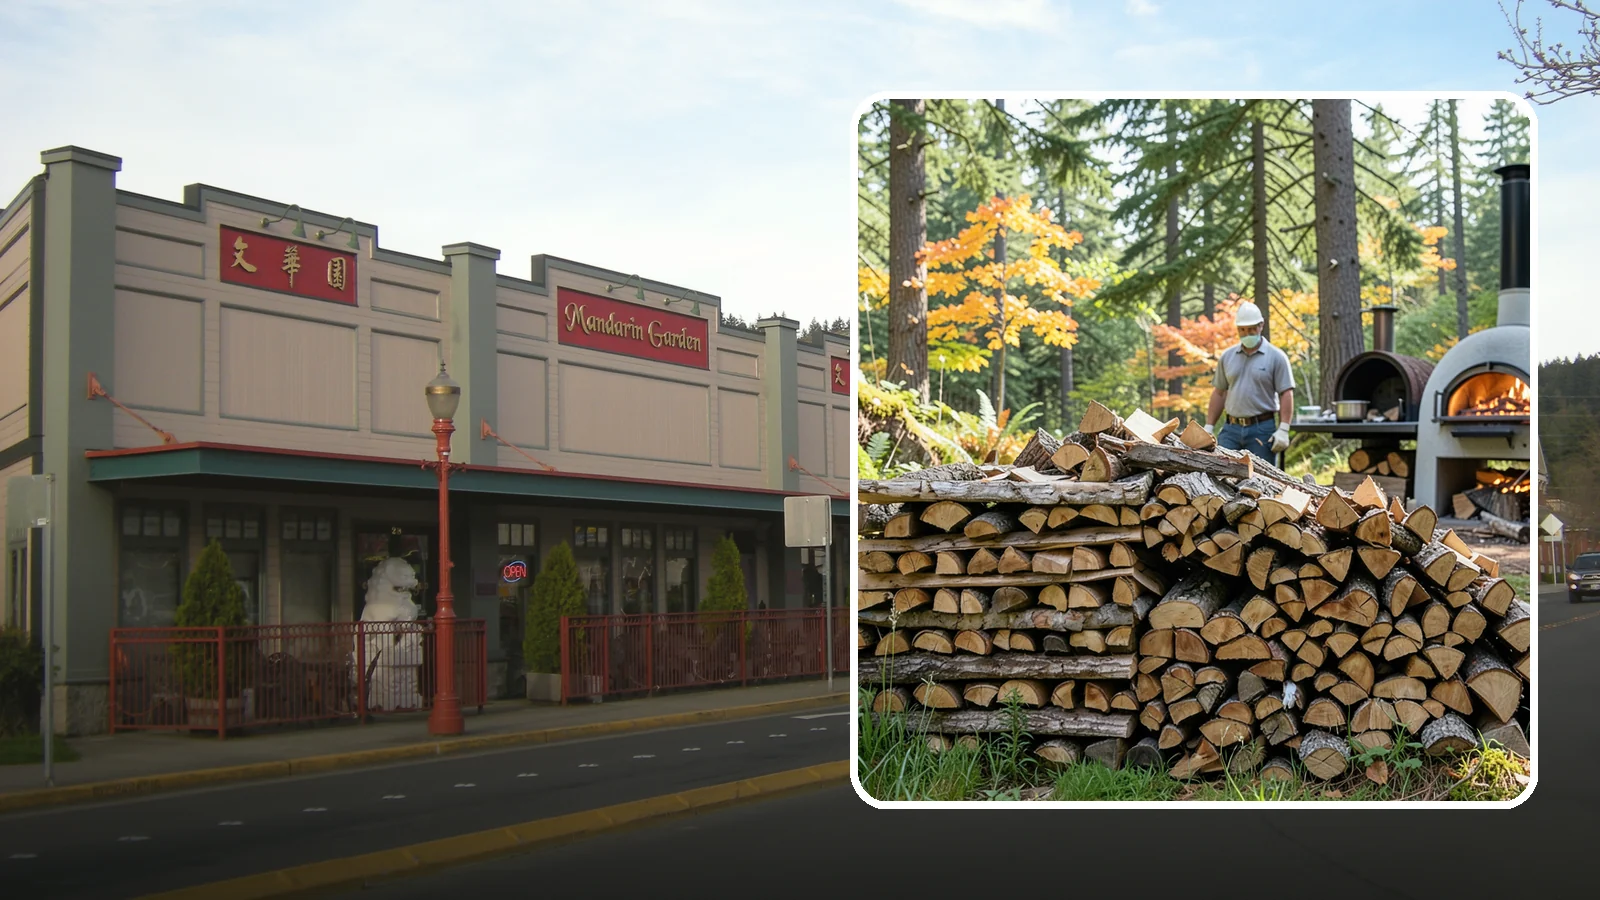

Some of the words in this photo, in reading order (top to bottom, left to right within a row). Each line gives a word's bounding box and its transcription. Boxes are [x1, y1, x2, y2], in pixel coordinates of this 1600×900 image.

[231, 235, 346, 291] 文華園
[564, 302, 644, 341] Mandarin
[648, 319, 702, 353] Garden
[503, 565, 527, 578] OPEN
